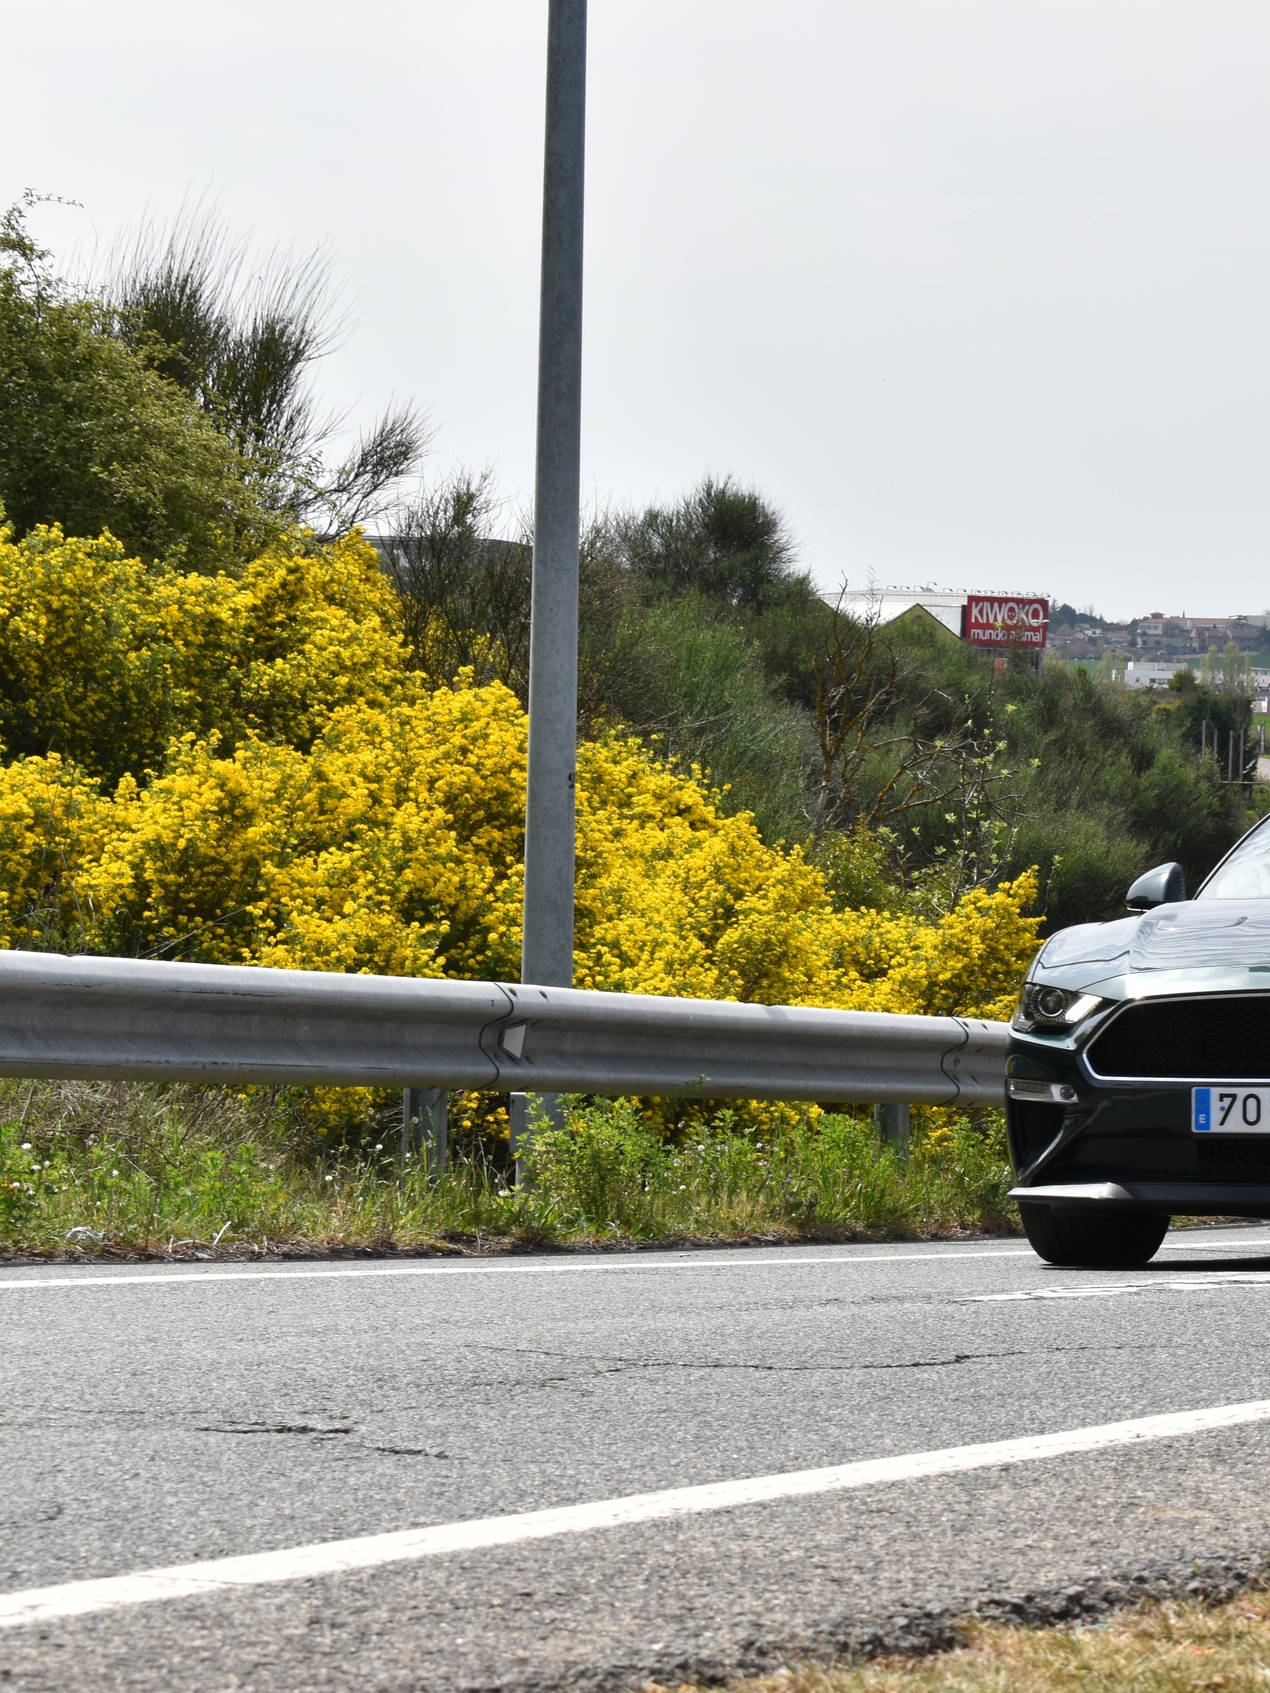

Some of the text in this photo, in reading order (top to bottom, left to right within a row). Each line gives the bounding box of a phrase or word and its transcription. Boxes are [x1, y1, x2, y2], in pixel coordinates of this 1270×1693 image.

[971, 601, 1044, 627] KIWOKO
[970, 627, 1008, 641] mundo
[1199, 1114, 1206, 1124] E
